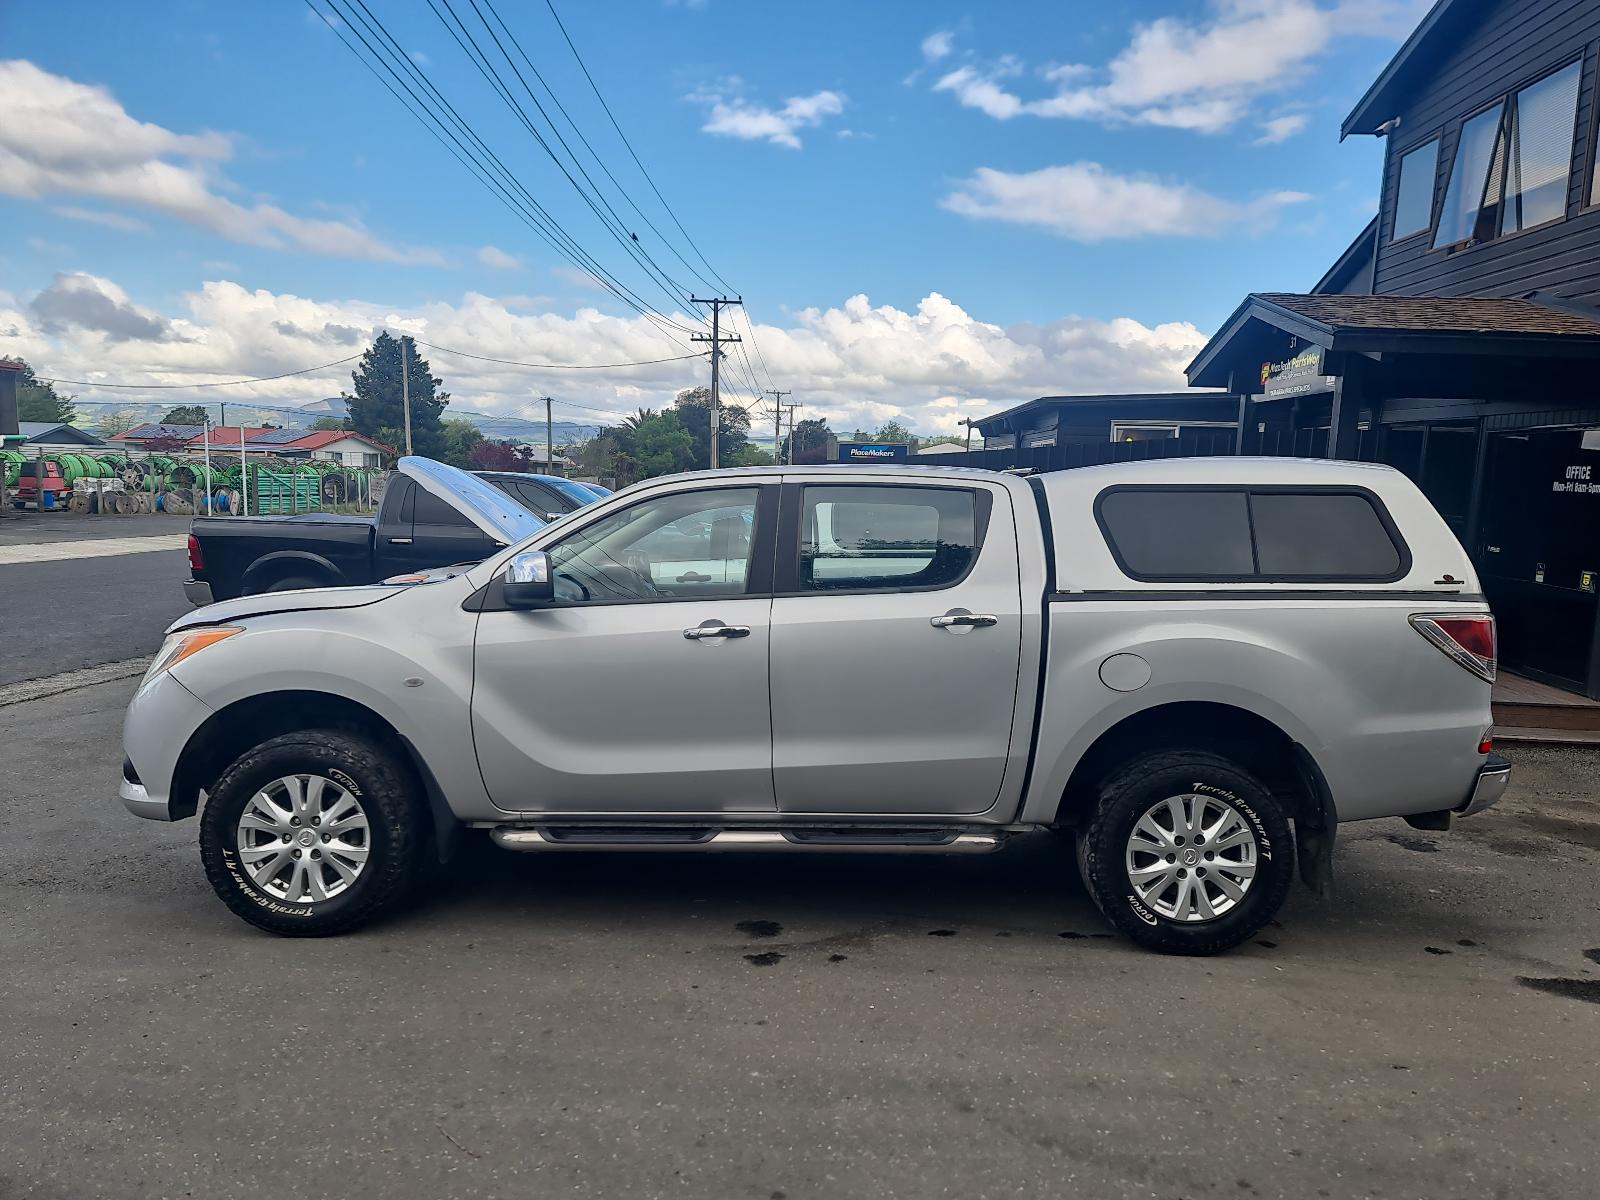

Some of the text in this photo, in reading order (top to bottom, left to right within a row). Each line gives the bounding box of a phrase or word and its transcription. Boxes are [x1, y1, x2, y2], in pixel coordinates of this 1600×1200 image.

[850, 448, 895, 457] PlaceMakers
[1565, 465, 1592, 480] OFFICE
[1192, 782, 1236, 801] Terrain
[1234, 798, 1267, 837] Grabber
[230, 871, 269, 907] Grabber
[267, 901, 314, 917] Terrain
[1126, 895, 1154, 919] DURUN
